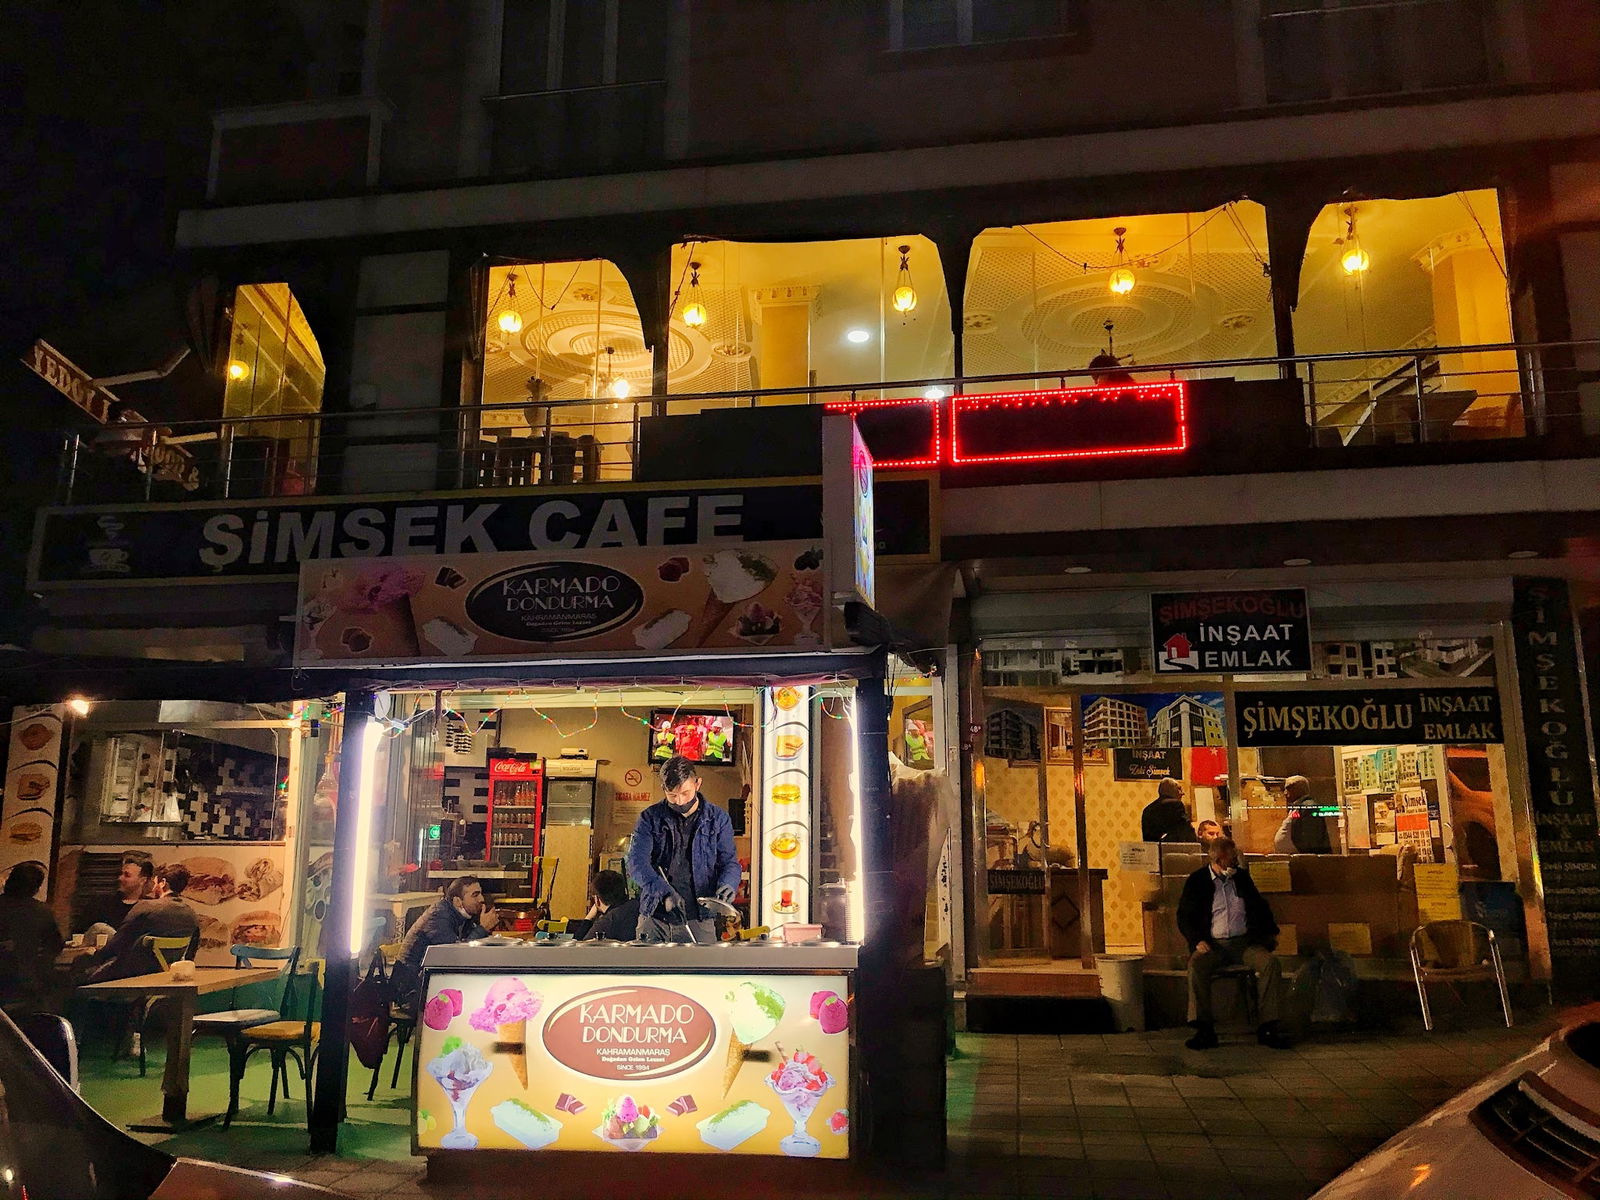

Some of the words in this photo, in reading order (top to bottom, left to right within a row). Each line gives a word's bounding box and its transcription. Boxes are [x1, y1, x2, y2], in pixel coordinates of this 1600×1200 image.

[528, 494, 745, 550] CAFE
[503, 575, 621, 596] KARMADO
[506, 594, 615, 612] DONDURMA
[1199, 622, 1294, 646] İNŞAAT
[1205, 649, 1293, 668] EMLAK
[1419, 693, 1493, 717] İNŞAAT
[1242, 697, 1414, 739] ŞİMŞEKOĞLU
[1422, 722, 1497, 740] EMLAK
[579, 1003, 695, 1024] KARMADO
[582, 1026, 688, 1044] DONDURMA
